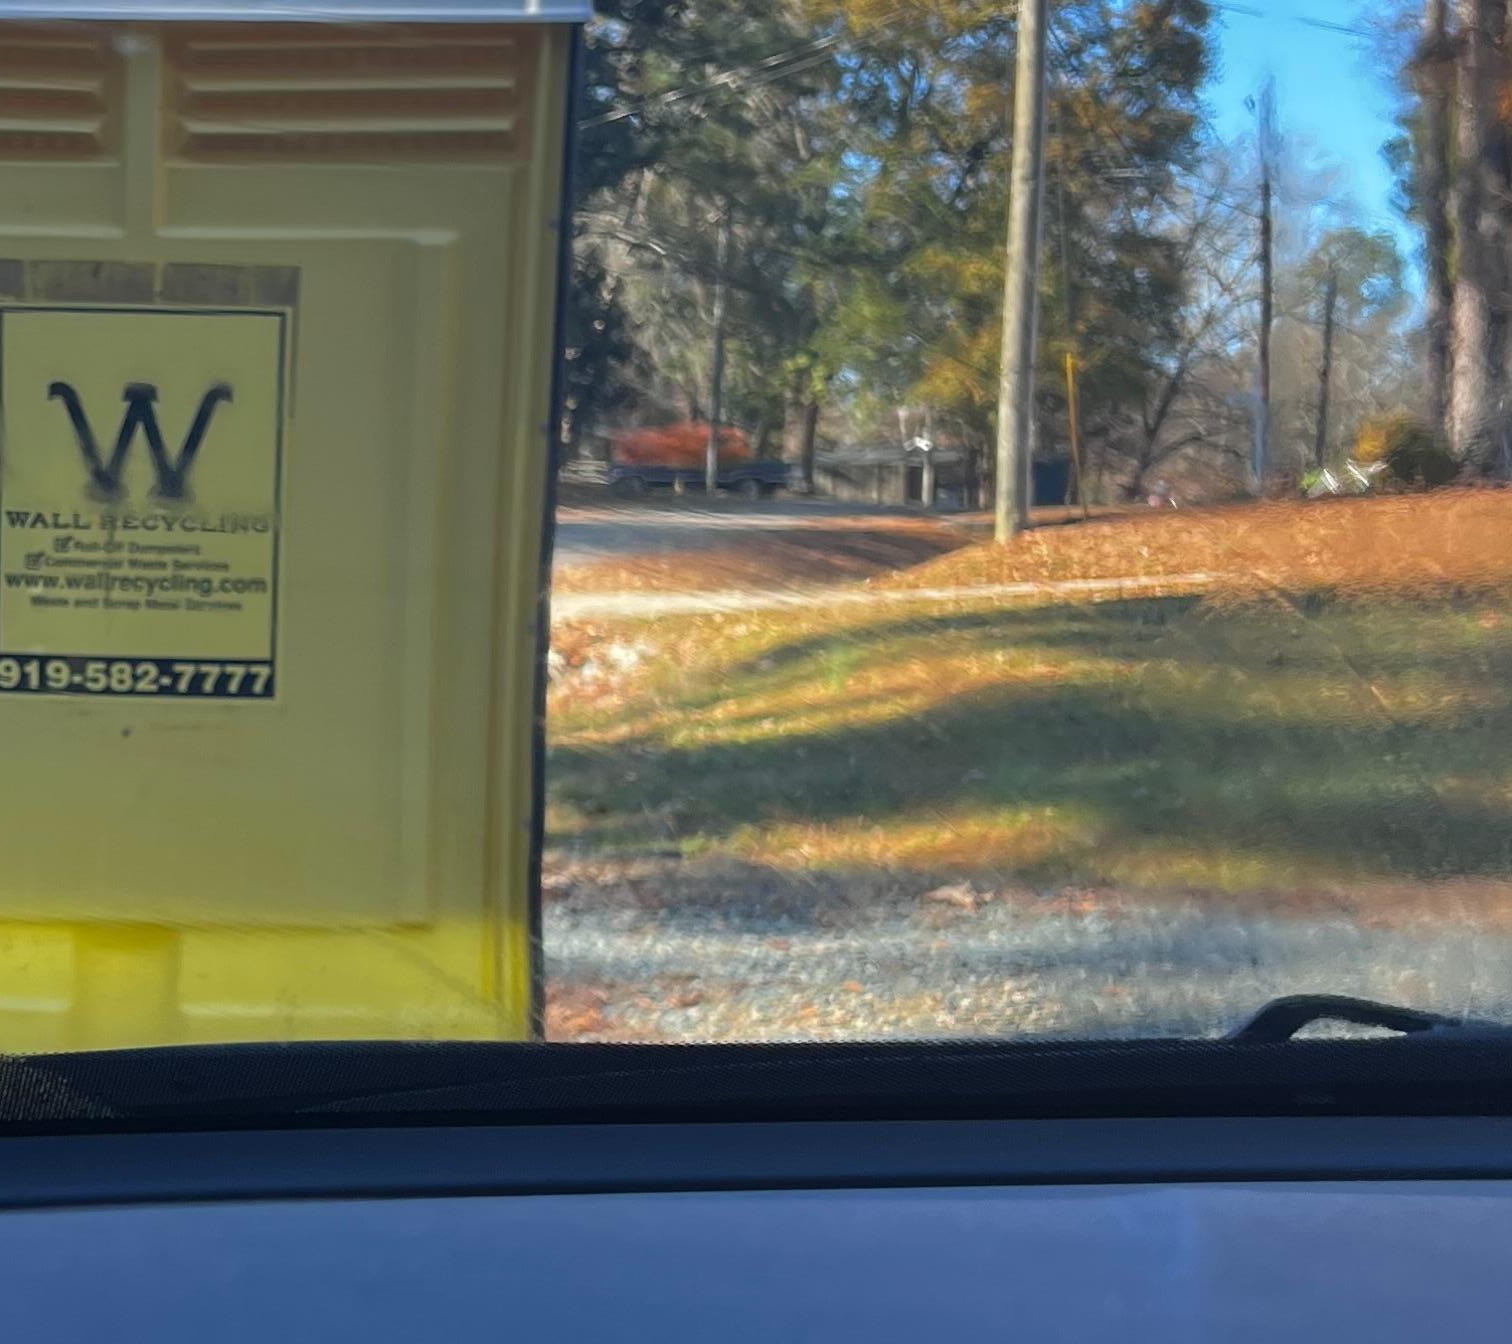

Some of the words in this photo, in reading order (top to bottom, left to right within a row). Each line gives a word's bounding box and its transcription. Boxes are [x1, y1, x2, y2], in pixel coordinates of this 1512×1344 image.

[48, 381, 233, 504] W
[6, 511, 90, 529] WALL
[100, 512, 270, 533] RECYCLING
[5, 572, 267, 596] www.wallrecycling.com
